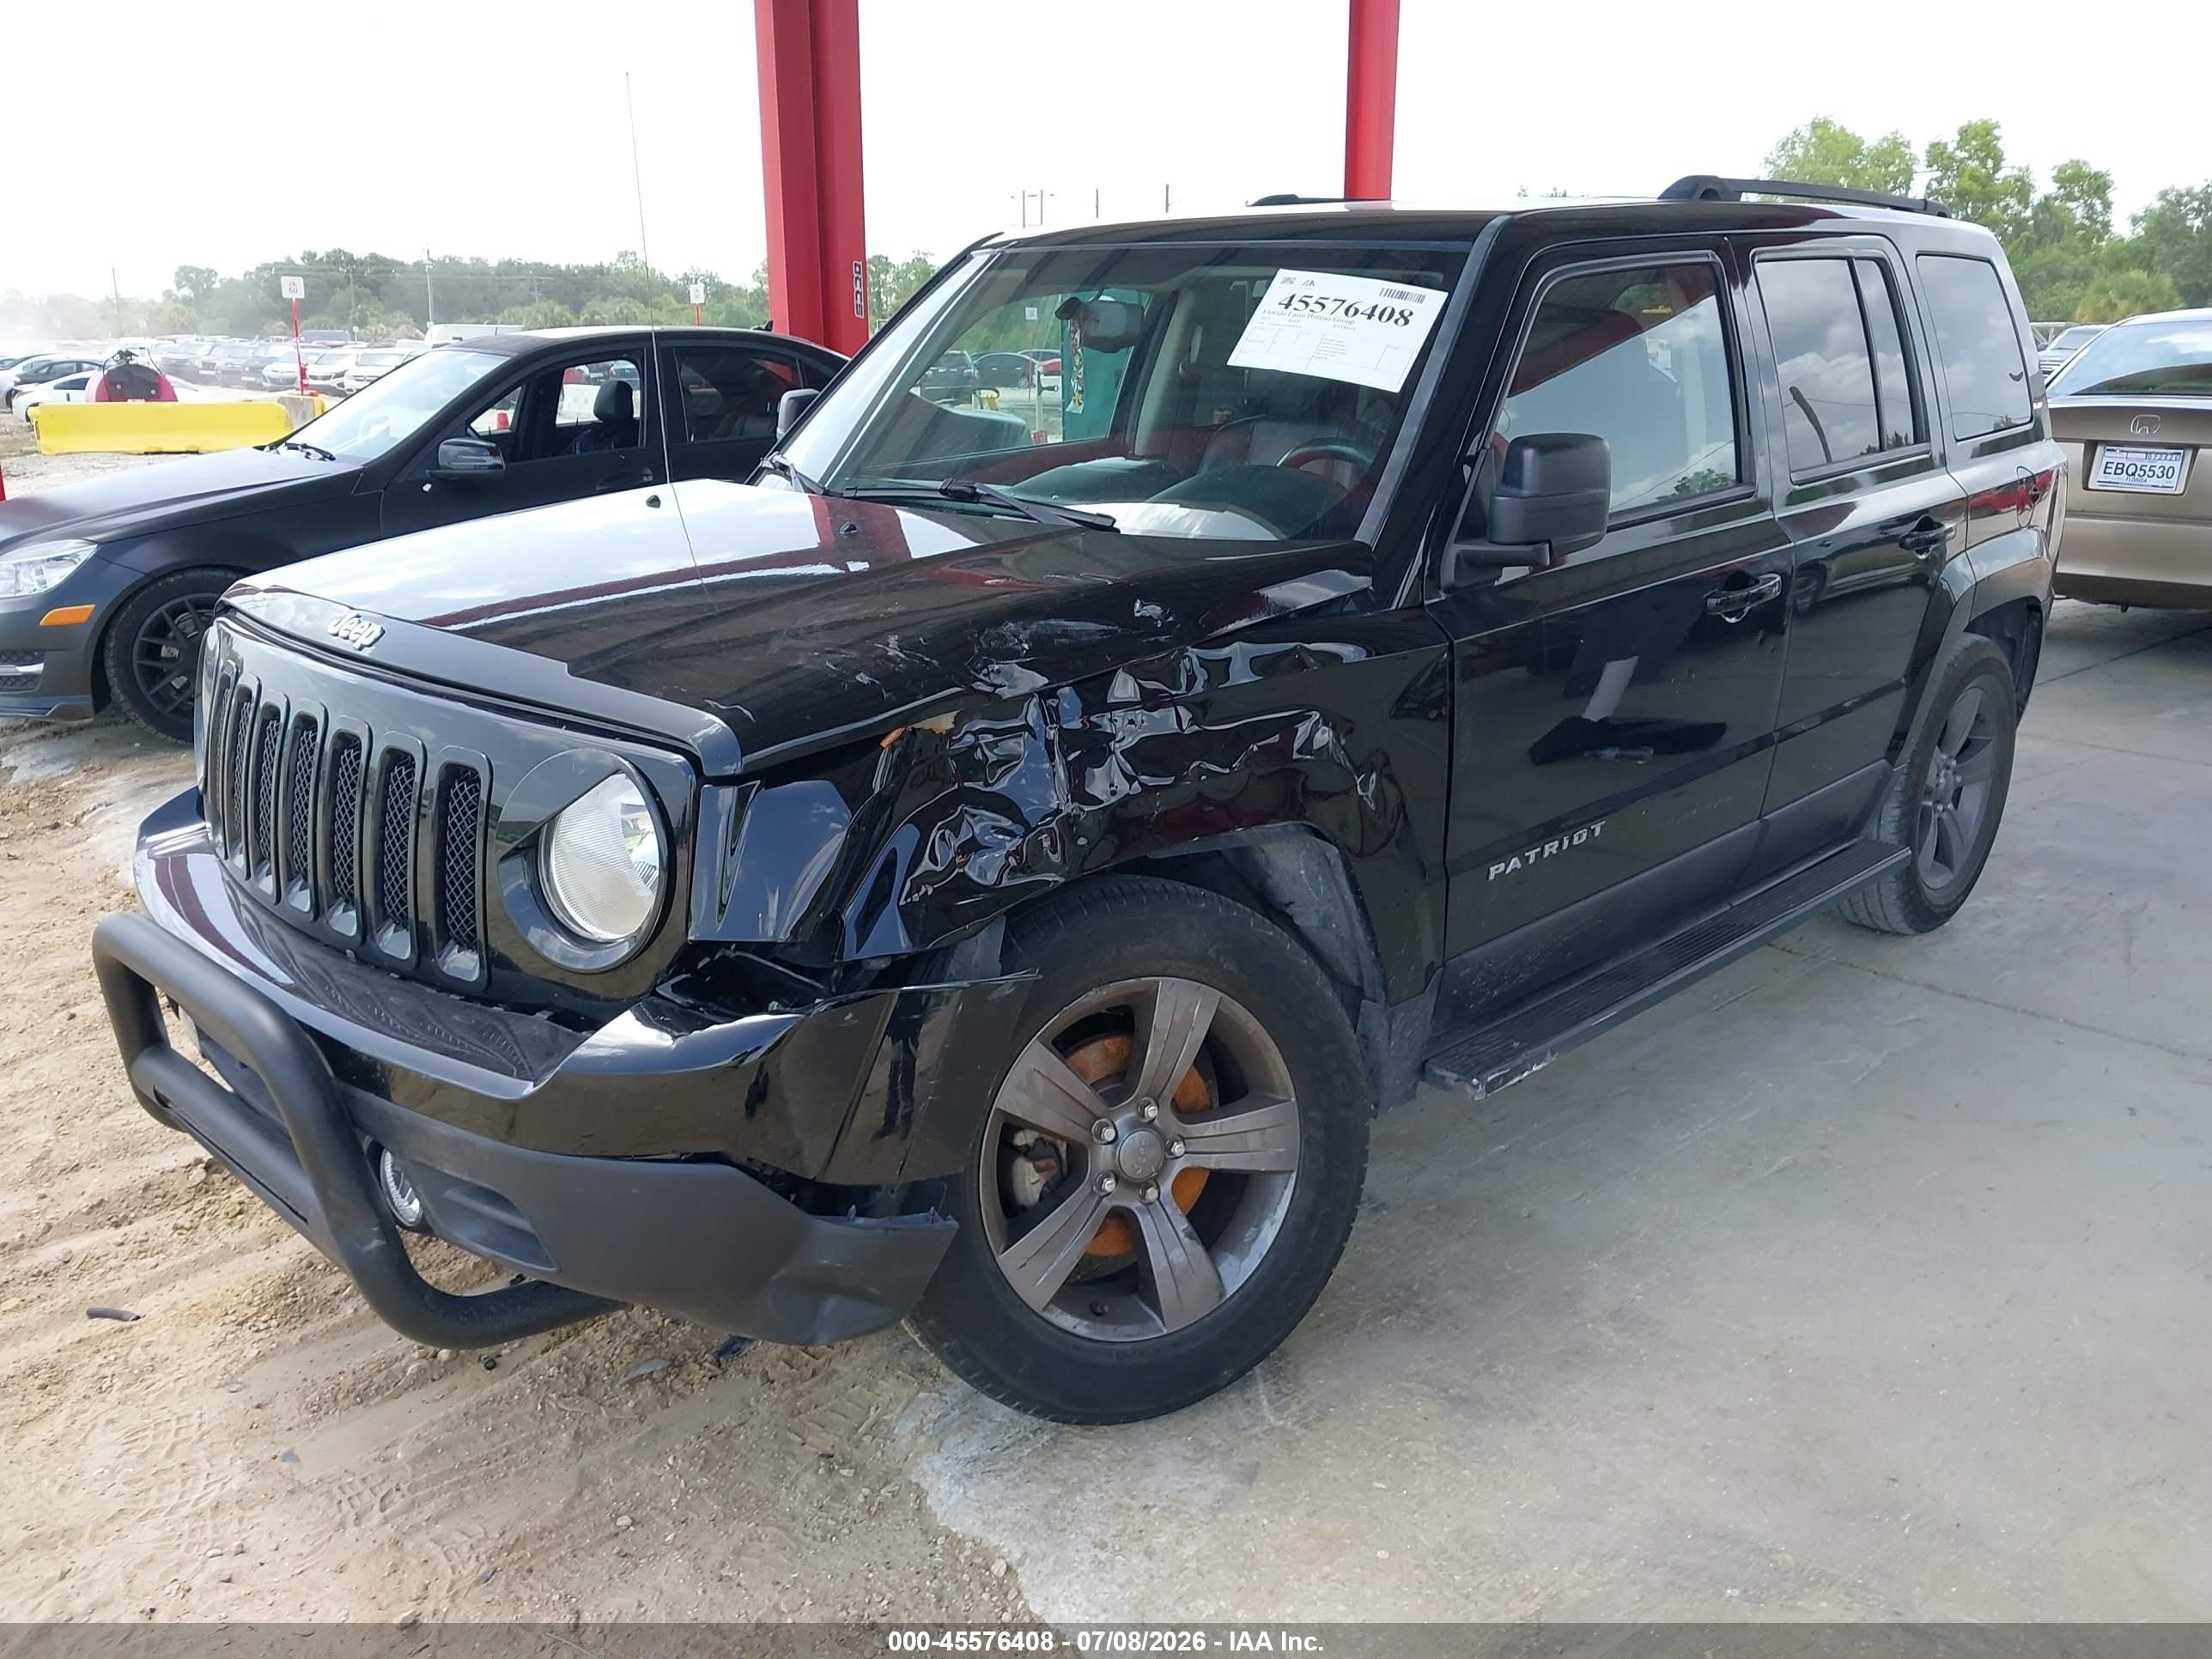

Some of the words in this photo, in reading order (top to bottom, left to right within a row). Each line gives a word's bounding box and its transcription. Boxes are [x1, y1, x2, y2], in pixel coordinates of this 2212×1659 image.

[1278, 293, 1414, 326] 45576408
[2103, 461, 2176, 480] EBQ5530
[327, 611, 386, 651] Jeep
[1488, 820, 1607, 881] PATRIOT
